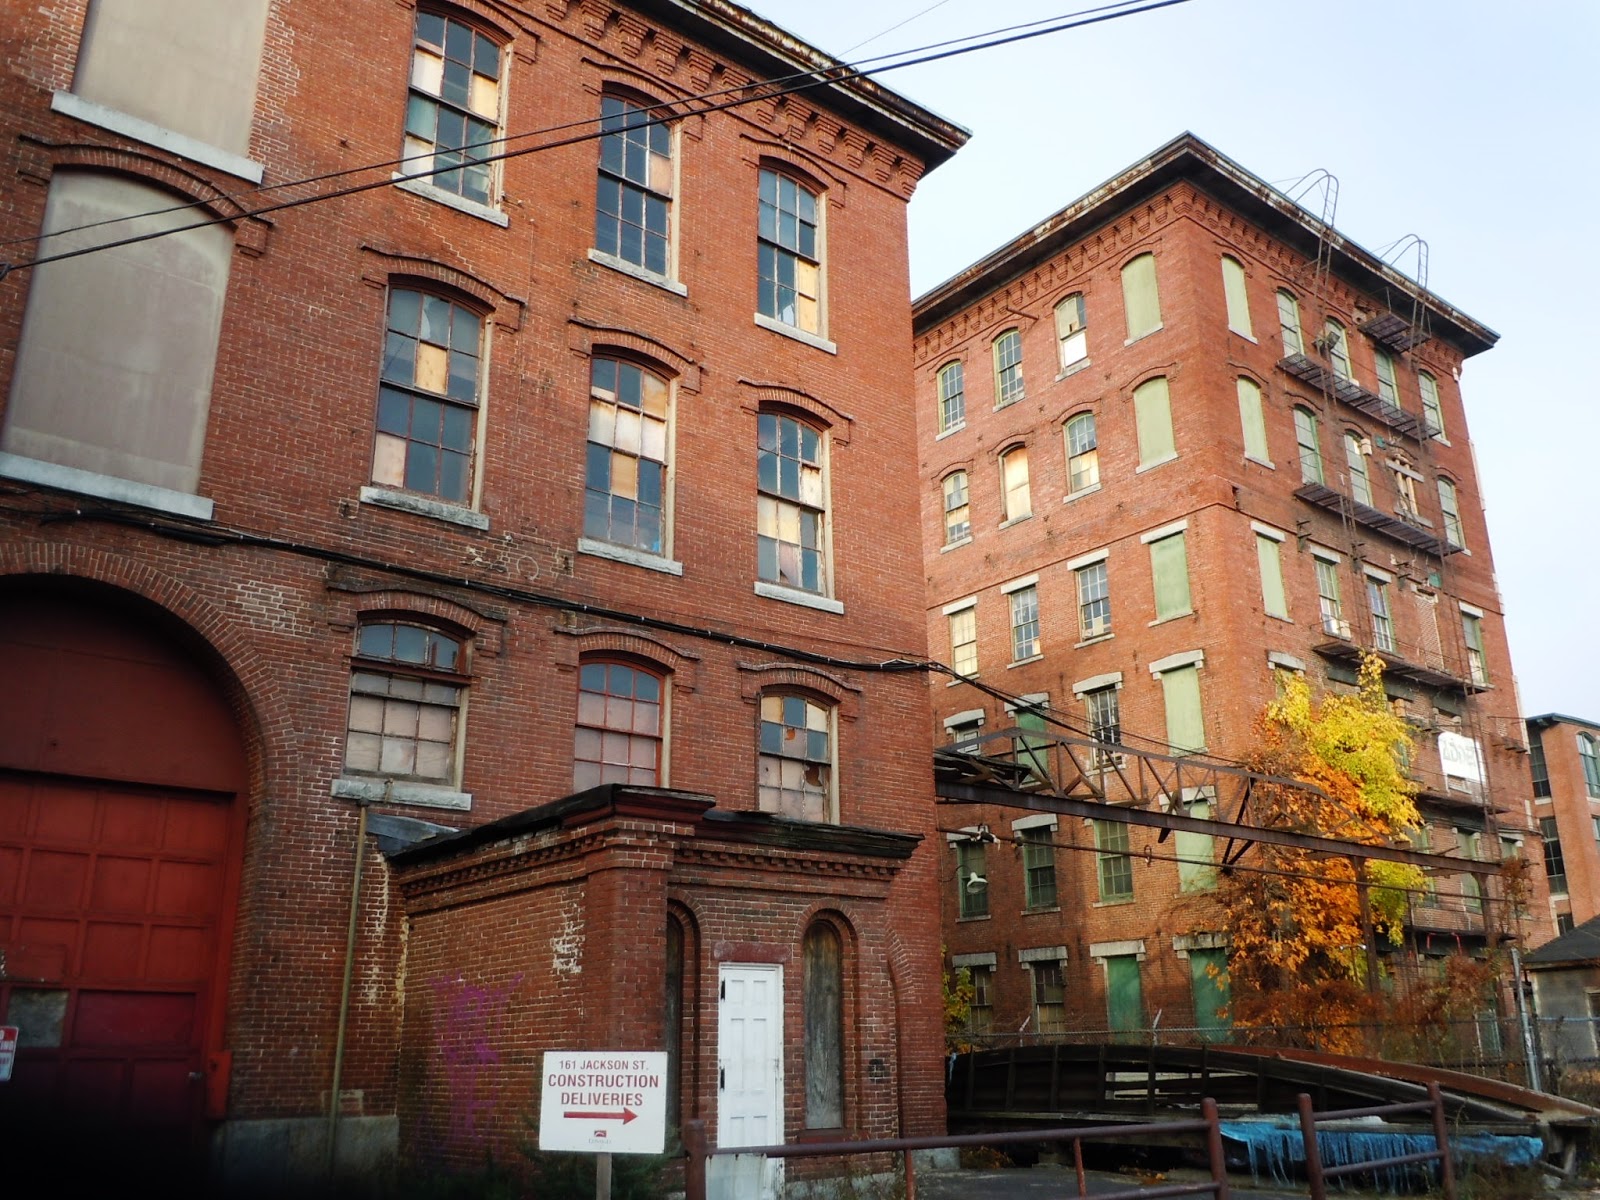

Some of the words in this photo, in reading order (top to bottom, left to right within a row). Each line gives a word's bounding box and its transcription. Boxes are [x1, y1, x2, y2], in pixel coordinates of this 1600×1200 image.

[559, 1060, 576, 1070] 161
[580, 1060, 629, 1070] JACKSON
[632, 1060, 649, 1070] ST.
[548, 1073, 659, 1088] CONSTRUCTION
[561, 1092, 643, 1107] DELIVERIES
